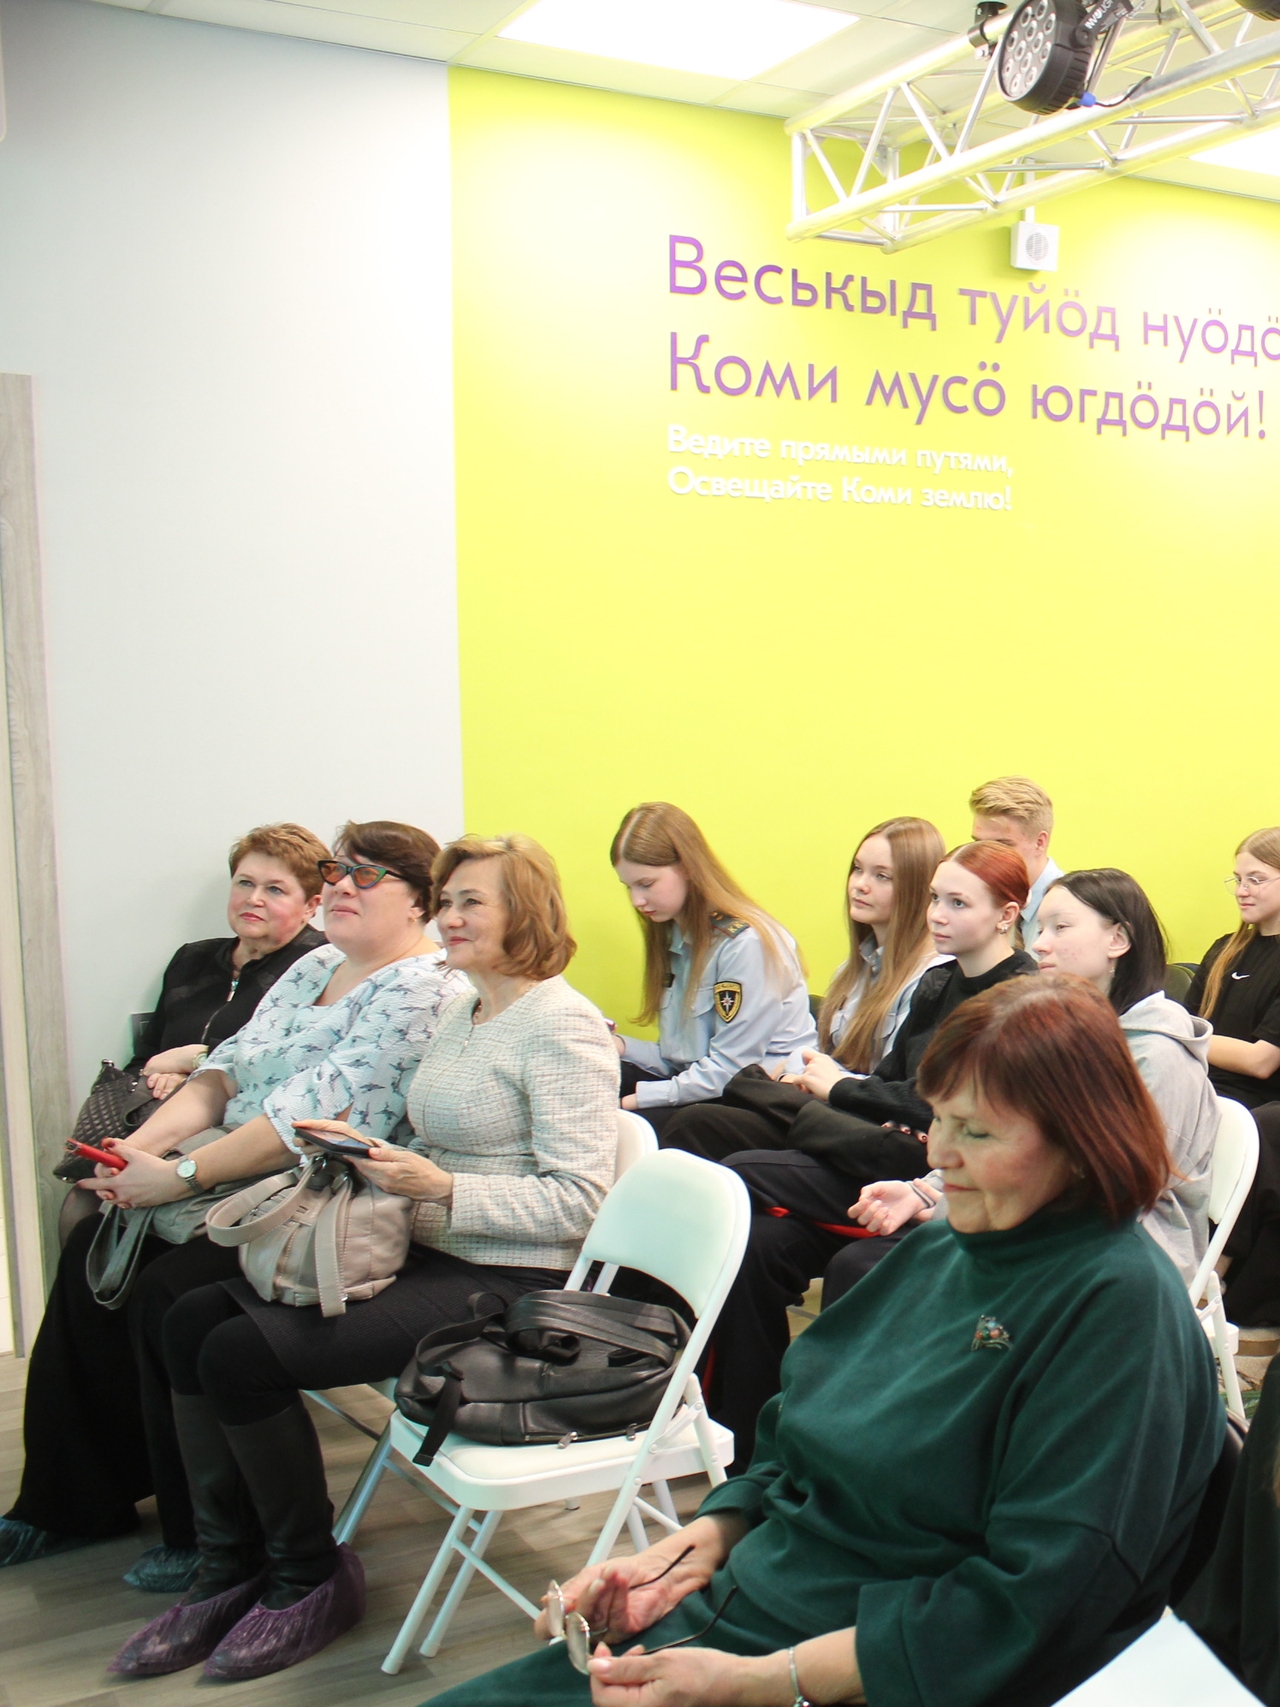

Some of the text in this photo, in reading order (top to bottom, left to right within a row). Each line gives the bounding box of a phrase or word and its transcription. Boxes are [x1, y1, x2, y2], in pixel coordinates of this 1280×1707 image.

[669, 234, 937, 331] Веськыд
[958, 282, 1120, 352] туйӧд
[670, 331, 1267, 442] Коми мусӧ югдӧдӧй!
[668, 424, 1013, 478] Ведите прямыми путями,
[668, 466, 1013, 511] Освещайте Коми землю!
